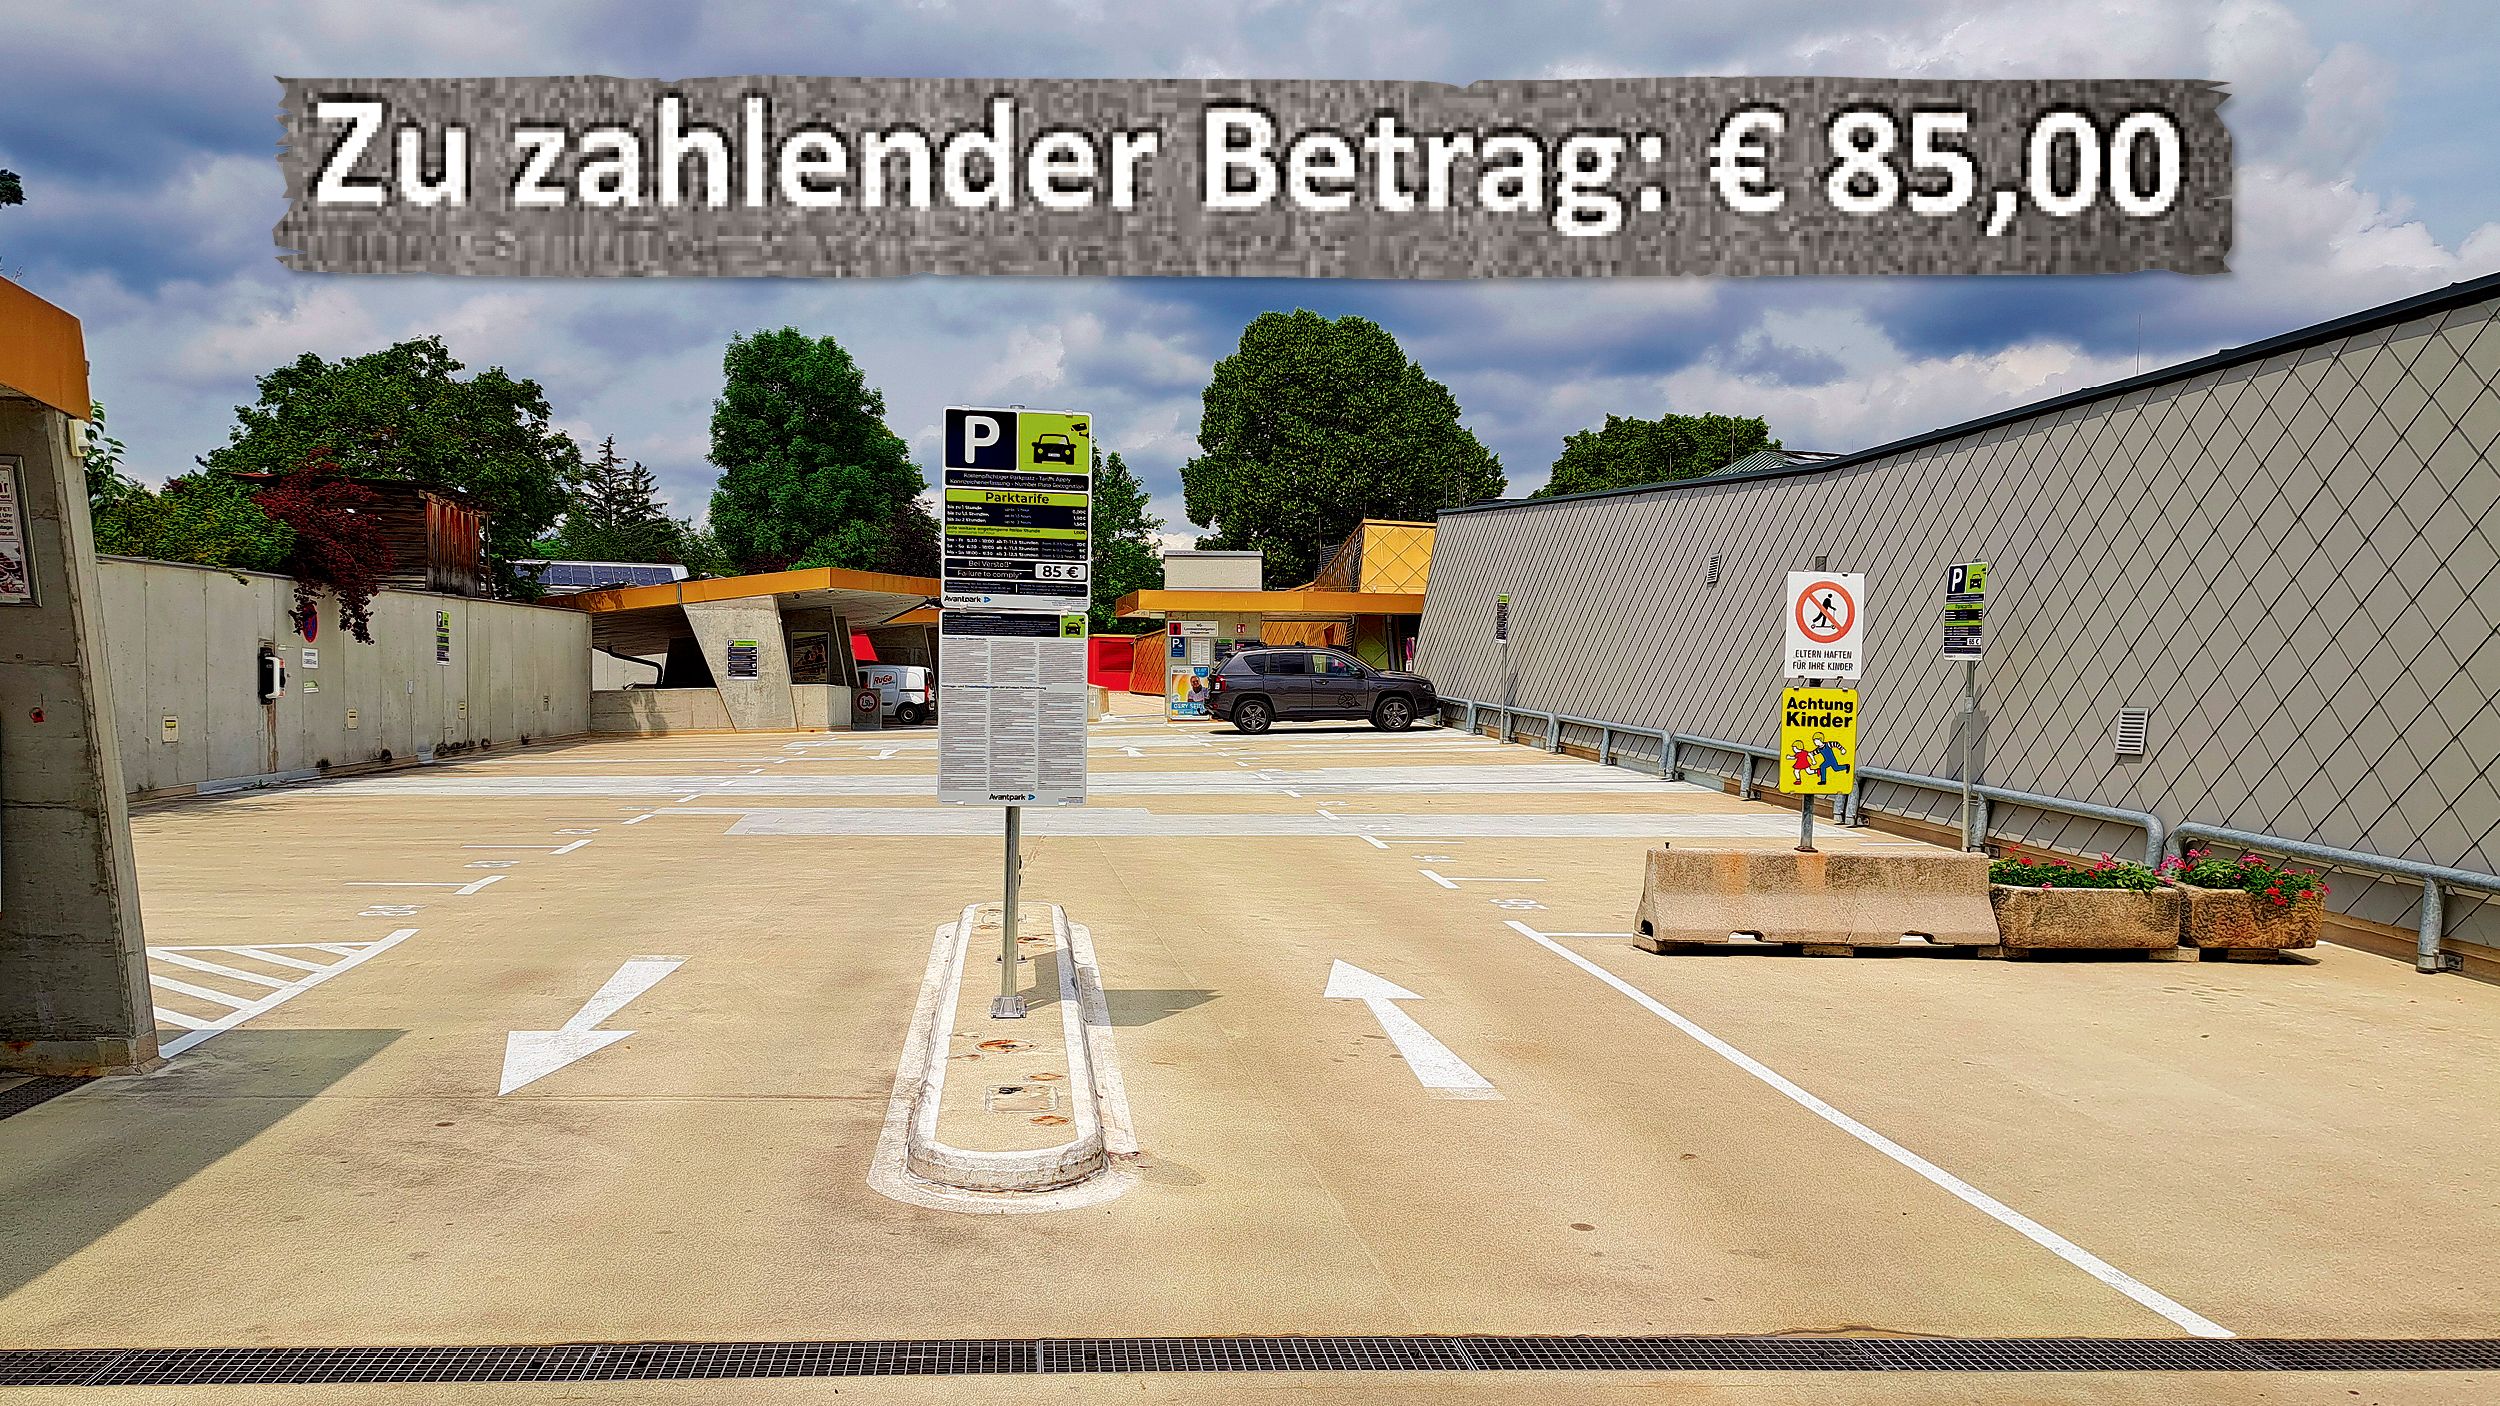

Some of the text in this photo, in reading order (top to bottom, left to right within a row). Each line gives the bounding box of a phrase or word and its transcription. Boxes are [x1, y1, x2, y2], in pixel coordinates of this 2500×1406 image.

[964, 415, 1000, 464] P
[986, 491, 1050, 504] Parktarife
[1042, 566, 1079, 578] 85 €
[1952, 568, 1962, 592] P
[944, 595, 981, 603] Avantpark
[438, 612, 442, 626] P
[1172, 638, 1180, 648] P
[1795, 650, 1852, 659] ELTERN HAFTEN
[1793, 660, 1853, 671] FÜR IHRE KINDER
[1787, 697, 1854, 713] Achtung
[1786, 711, 1853, 728] Kinder
[989, 793, 1026, 802] Avantpark
